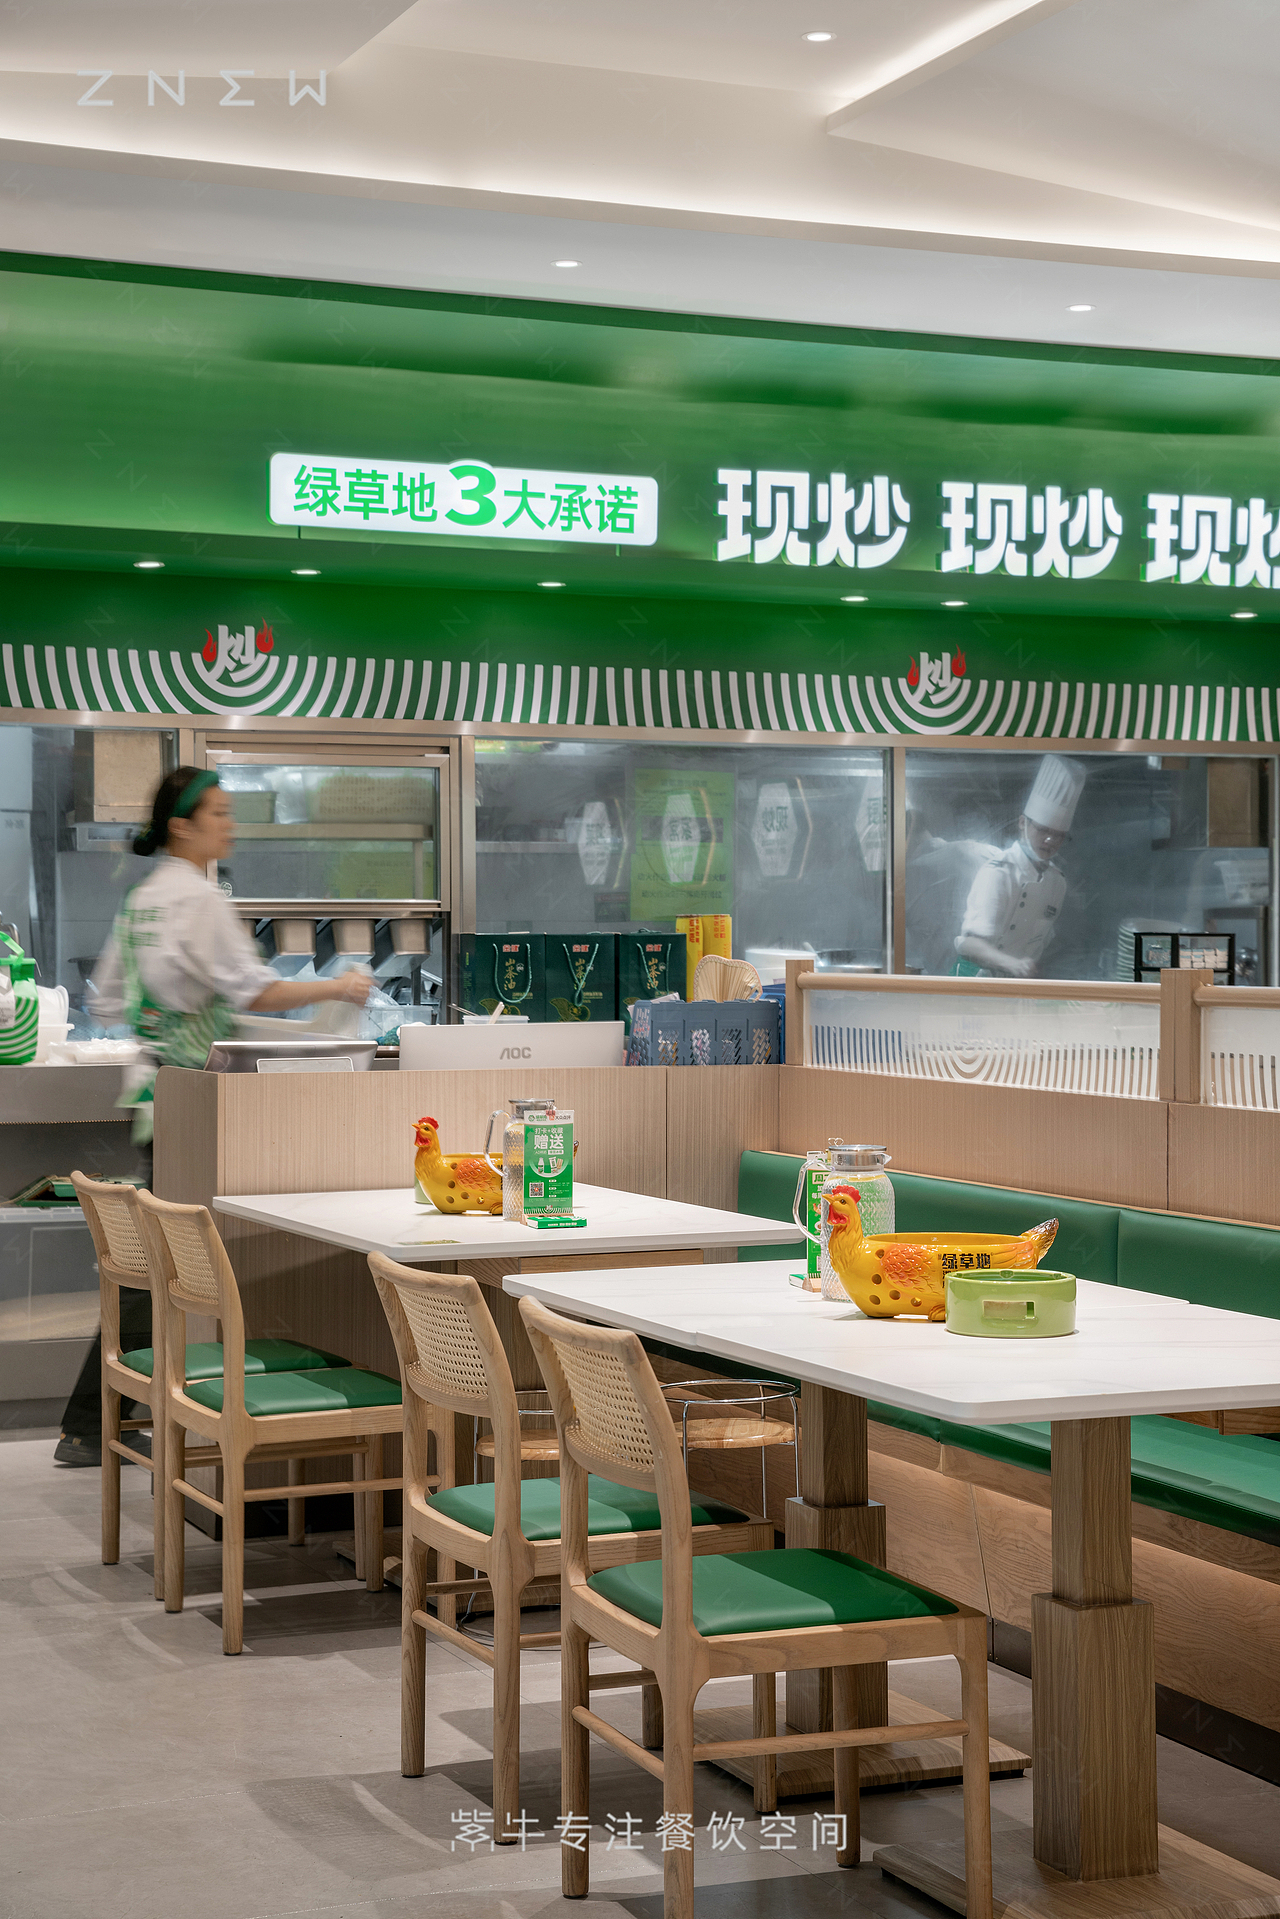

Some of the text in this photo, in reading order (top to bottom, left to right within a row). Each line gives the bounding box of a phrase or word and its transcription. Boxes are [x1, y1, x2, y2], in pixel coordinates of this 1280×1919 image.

[293, 464, 639, 534] 绿草地3大承诺
[715, 468, 910, 569] 现炒
[938, 481, 1123, 580] 现炒
[504, 958, 519, 991] 山茶油
[499, 1046, 532, 1060] AOC
[534, 1134, 564, 1150] 赠送
[941, 1253, 991, 1270] 绿草地
